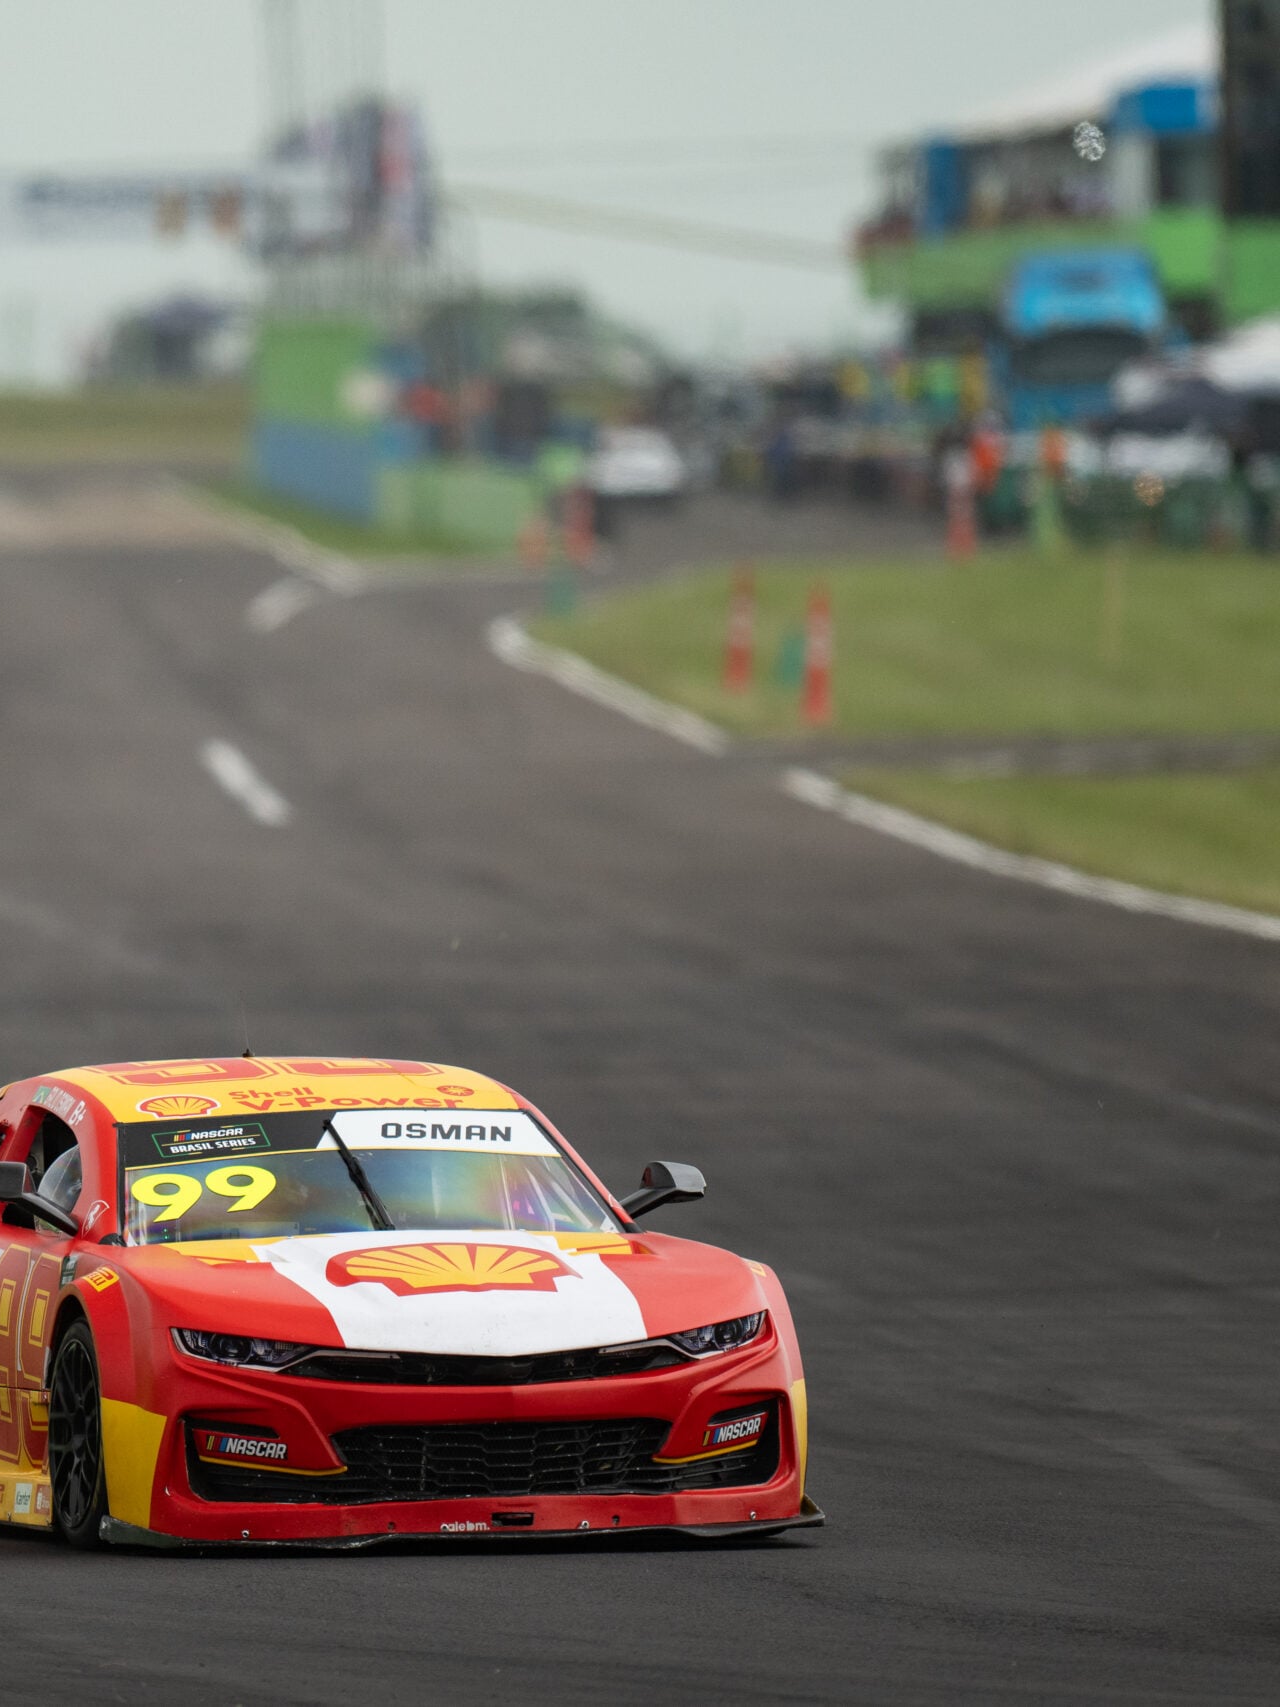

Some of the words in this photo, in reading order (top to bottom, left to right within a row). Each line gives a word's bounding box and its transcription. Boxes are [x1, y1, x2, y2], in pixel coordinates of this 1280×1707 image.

[228, 1087, 314, 1100] Shell
[237, 1096, 464, 1111] V-Power
[190, 1127, 243, 1140] NASCAR
[381, 1122, 512, 1142] OSMAN
[170, 1142, 214, 1154] BRASIL
[216, 1137, 256, 1149] SERIES
[130, 1165, 277, 1223] 99
[718, 1417, 761, 1442] NASCAR
[225, 1438, 287, 1460] NASCAR
